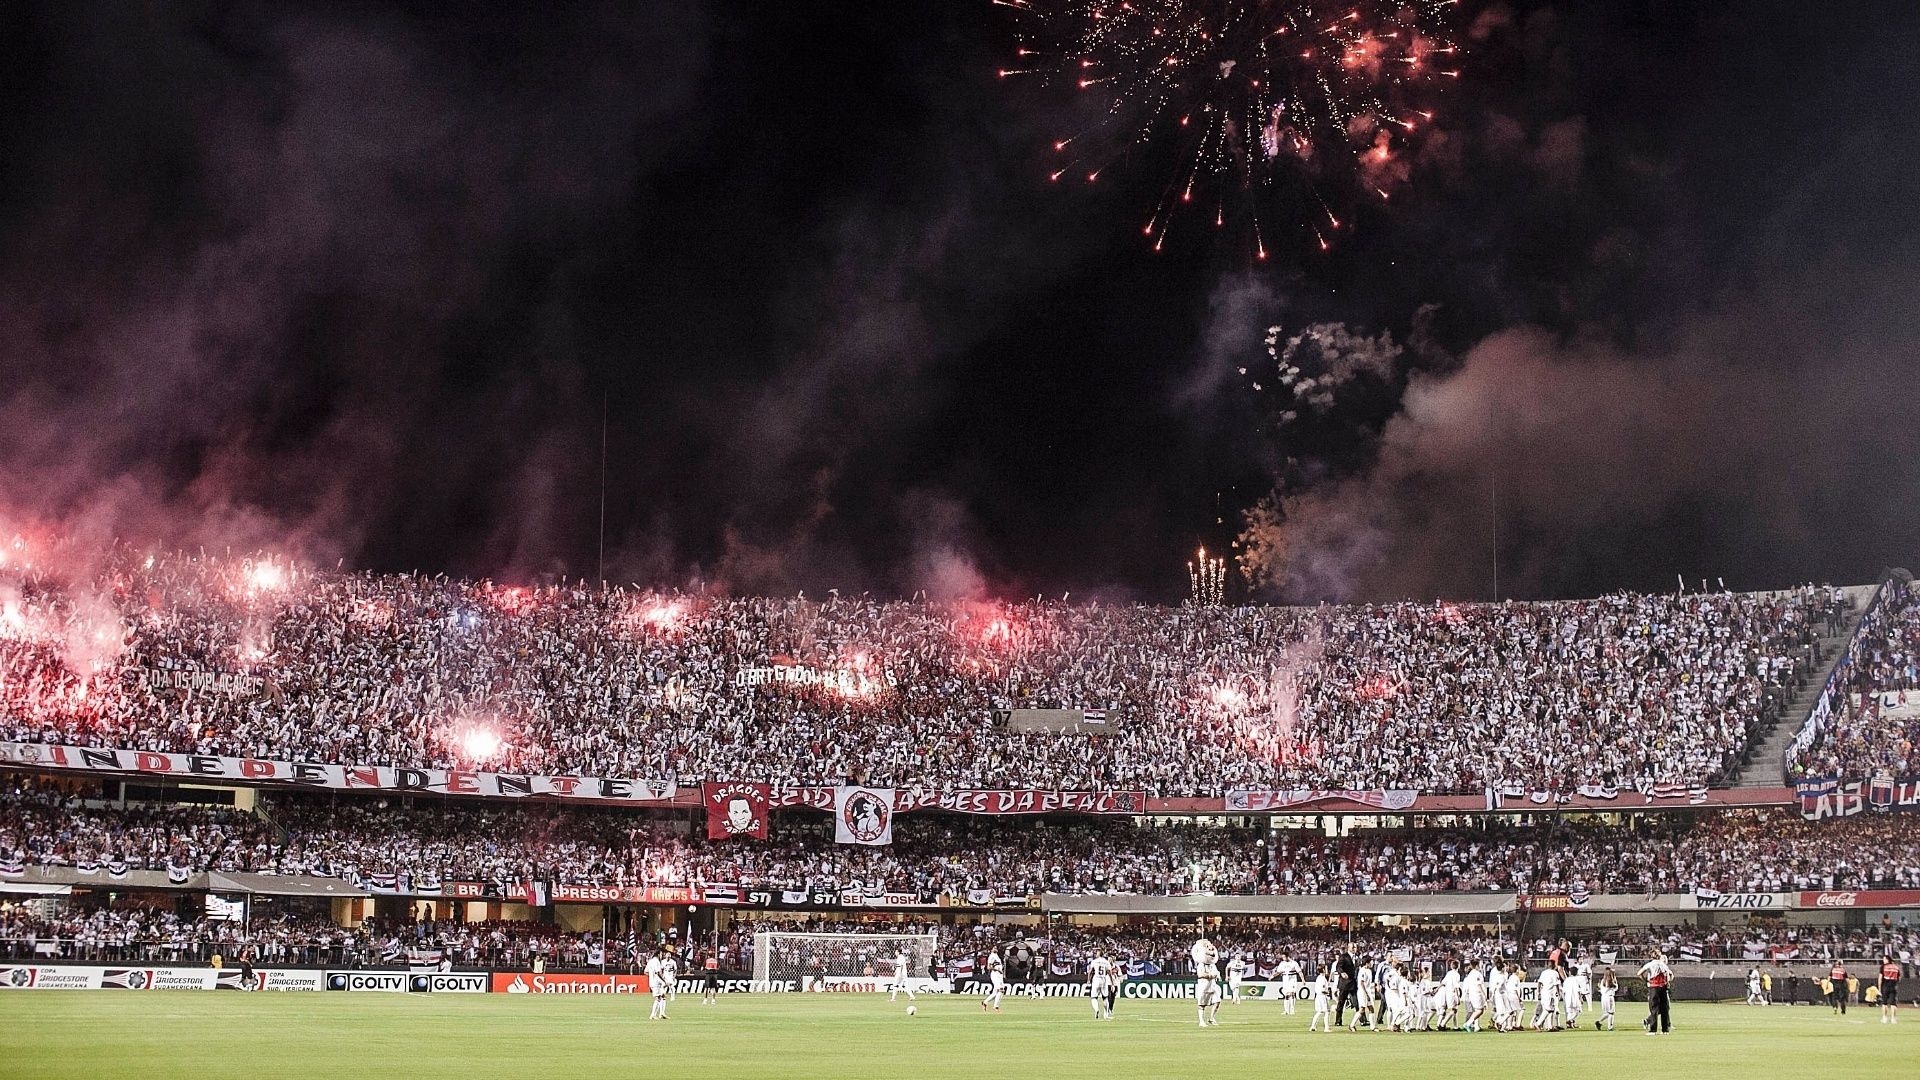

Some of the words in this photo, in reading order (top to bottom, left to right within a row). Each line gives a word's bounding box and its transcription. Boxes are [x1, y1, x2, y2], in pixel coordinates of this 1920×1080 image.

[992, 711, 1011, 727] 07
[50, 745, 633, 799] INDEPENDENTE
[998, 792, 1034, 812] DA
[1041, 792, 1109, 812] REAL
[551, 886, 619, 900] SPRESSO
[155, 976, 205, 984] BRIDGESTONE
[268, 978, 316, 986] BRIDGESTONE
[352, 977, 403, 989] GOLTV
[434, 978, 484, 990] GOLTV
[532, 976, 638, 993] Santander
